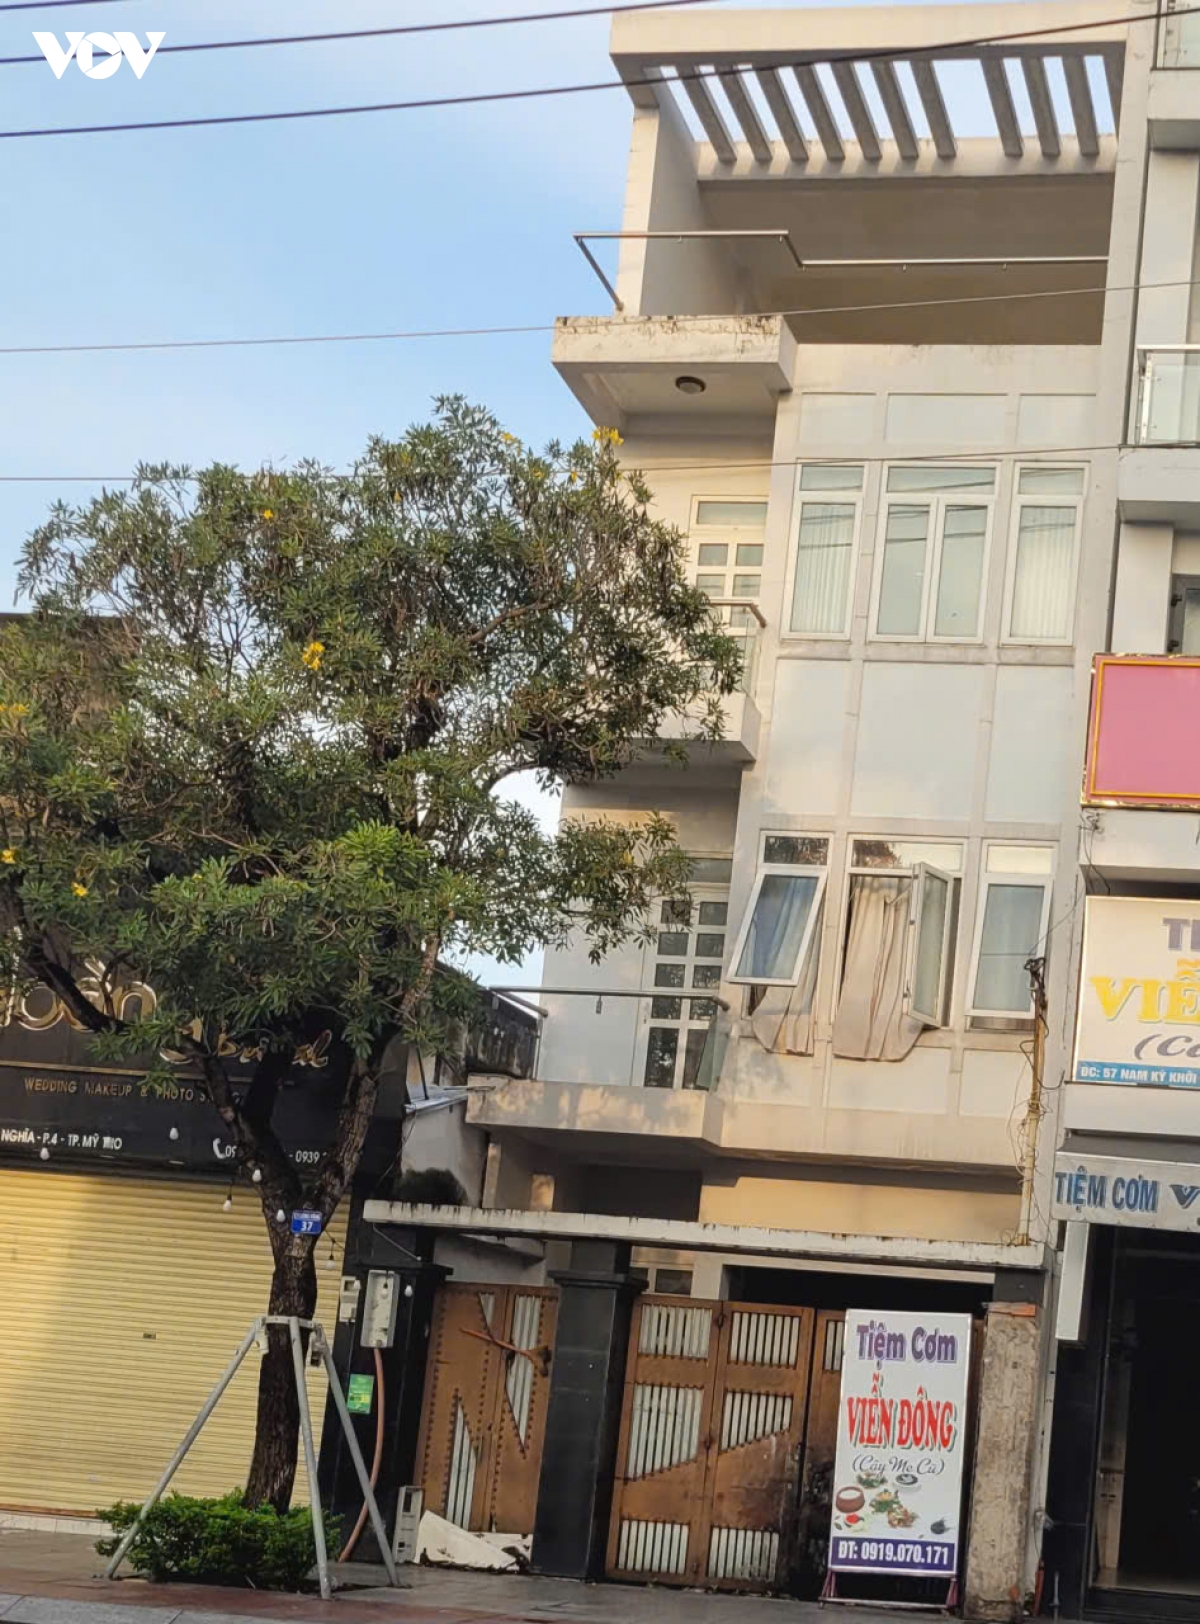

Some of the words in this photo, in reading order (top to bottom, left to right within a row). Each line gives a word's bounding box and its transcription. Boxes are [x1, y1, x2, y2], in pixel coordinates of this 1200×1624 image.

[24, 1077, 77, 1094] WEDDING
[85, 1081, 132, 1097] MAKEUP
[1120, 1069, 1147, 1081] NAM
[1055, 1165, 1107, 1213] TIỆM
[1112, 1174, 1159, 1213] CƠM
[856, 1320, 906, 1370] Tiệm
[911, 1326, 958, 1363] Cơm
[847, 1372, 898, 1448] VIỄN
[897, 1385, 958, 1452] ĐÔNG
[861, 1541, 949, 1565] 0919.070.171
